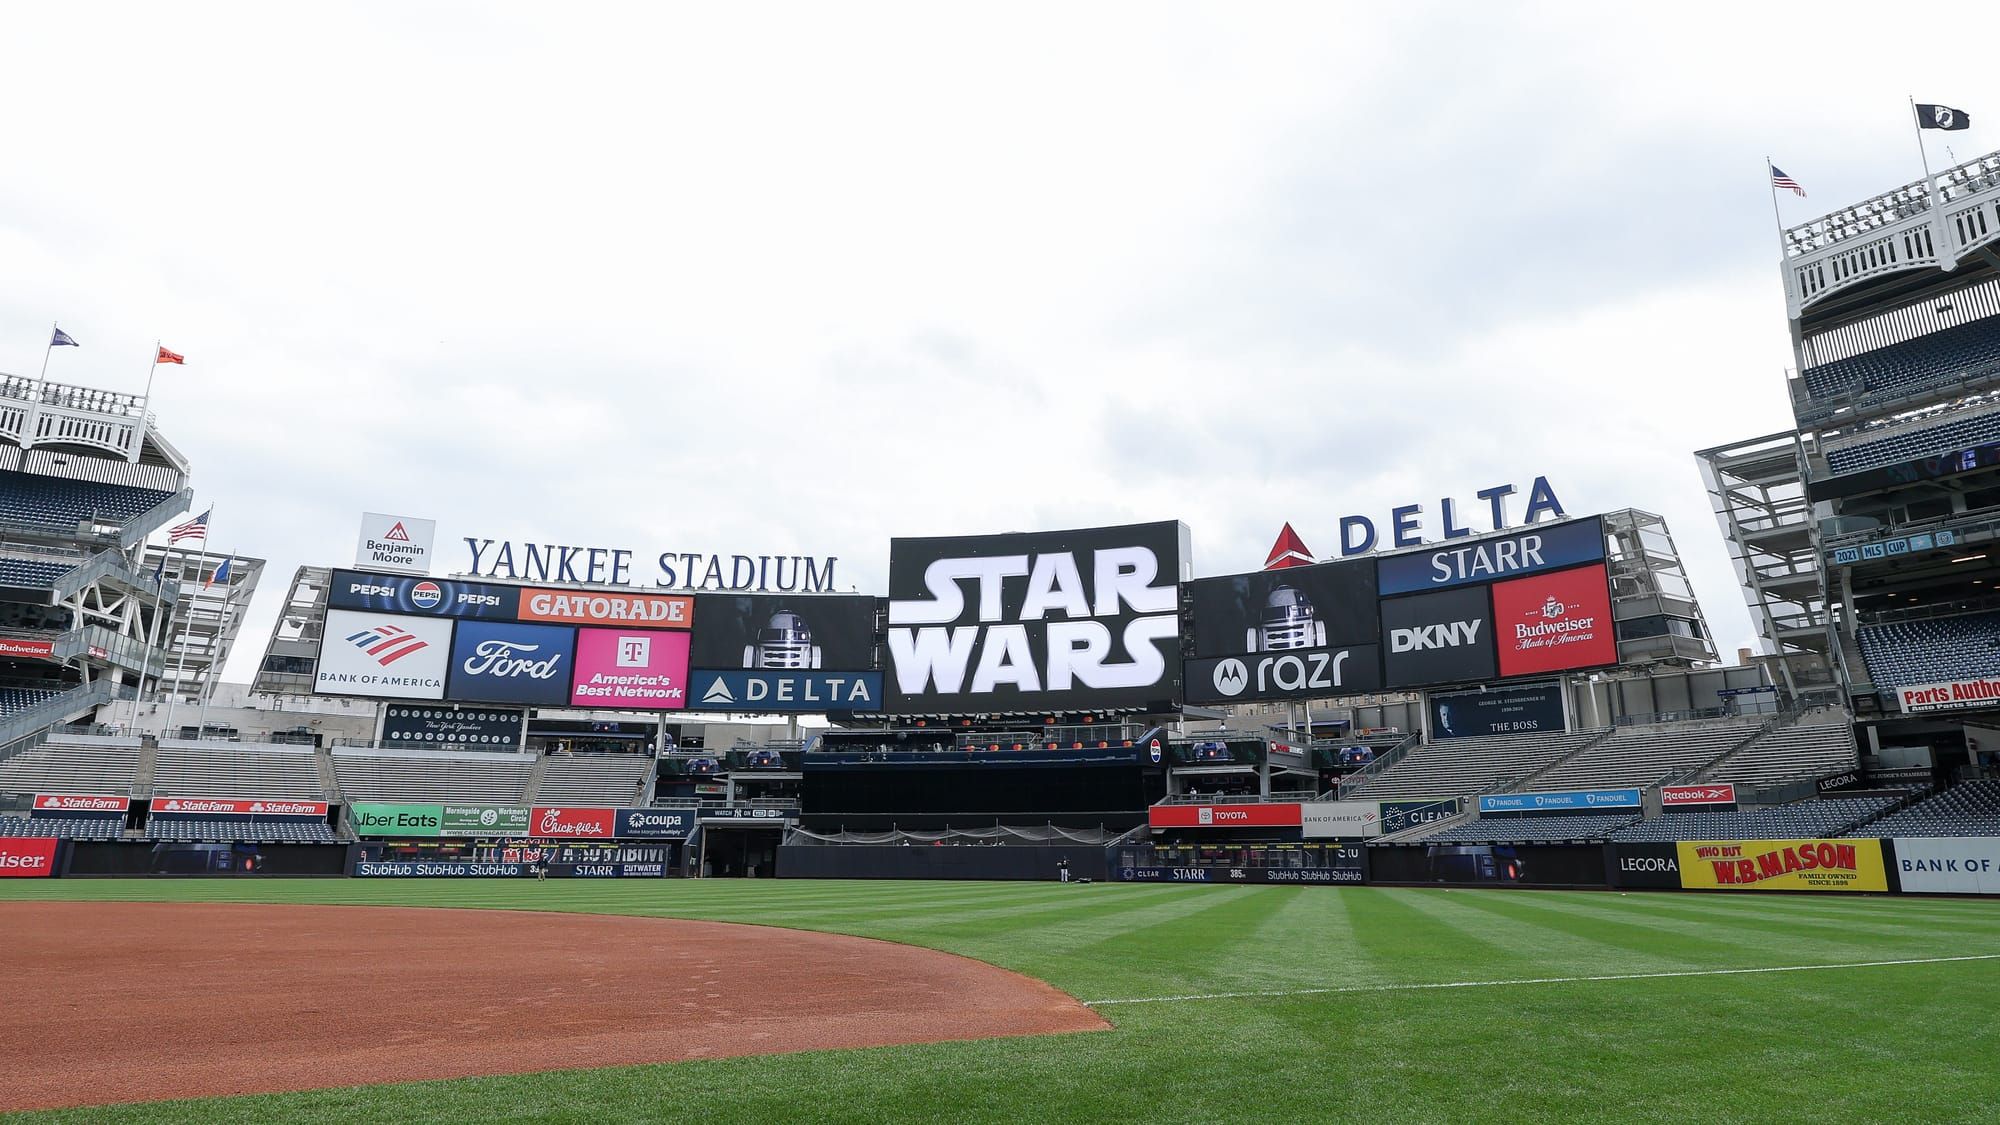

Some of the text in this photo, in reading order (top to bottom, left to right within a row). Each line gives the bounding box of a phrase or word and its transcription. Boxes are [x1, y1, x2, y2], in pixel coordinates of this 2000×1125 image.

[1339, 476, 1565, 556] DELTA
[366, 539, 424, 556] Benjamin
[1837, 541, 1905, 562] 2021 MLS CUP
[372, 551, 413, 565] Moore
[463, 537, 838, 592] YANKEE STADIUM
[1431, 535, 1545, 582] STARR
[350, 584, 395, 597] PEPSI
[889, 546, 1178, 624] STAR
[413, 590, 440, 600] PEPSI
[458, 593, 500, 606] PEPSI
[530, 594, 685, 622] GATORADE
[1541, 601, 1564, 618] 150
[1515, 617, 1594, 639] Budweiser
[1391, 619, 1482, 654] DKNY
[1515, 632, 1593, 650] Made of America
[0, 644, 48, 655] Budweiser
[888, 614, 1179, 695] WARS
[464, 640, 561, 680] Ford
[1257, 650, 1350, 692] razr
[320, 672, 441, 688] BANK OF AMERICA
[589, 673, 671, 686] America's
[576, 684, 682, 699] Best Network
[746, 678, 871, 702] DELTA
[1904, 680, 2000, 705] Parts Autho
[1937, 702, 1964, 710] Parts
[1490, 720, 1538, 732] THE BOSS
[1820, 774, 1858, 790] LEGORA
[1664, 790, 1705, 801] Reebok
[446, 807, 480, 816] Morningside
[1215, 812, 1248, 820] TOYOTA
[397, 814, 438, 827] Eats
[541, 810, 602, 835] Chick-fil-A
[646, 816, 682, 828] coupa
[1696, 846, 1742, 858] WHO BUT
[361, 864, 412, 876] StubHub
[416, 864, 469, 876] StubHub
[470, 864, 518, 876] StubHub
[576, 864, 614, 876] STARR
[1621, 858, 1677, 872] LEGORA
[1902, 860, 1958, 872] BANK
[1964, 860, 1990, 872] OF
[1173, 868, 1205, 880] STARR
[1230, 869, 1243, 878] 385
[1268, 870, 1298, 880] StubHub
[1301, 870, 1330, 880] StubHub
[1332, 870, 1362, 881] StubHub
